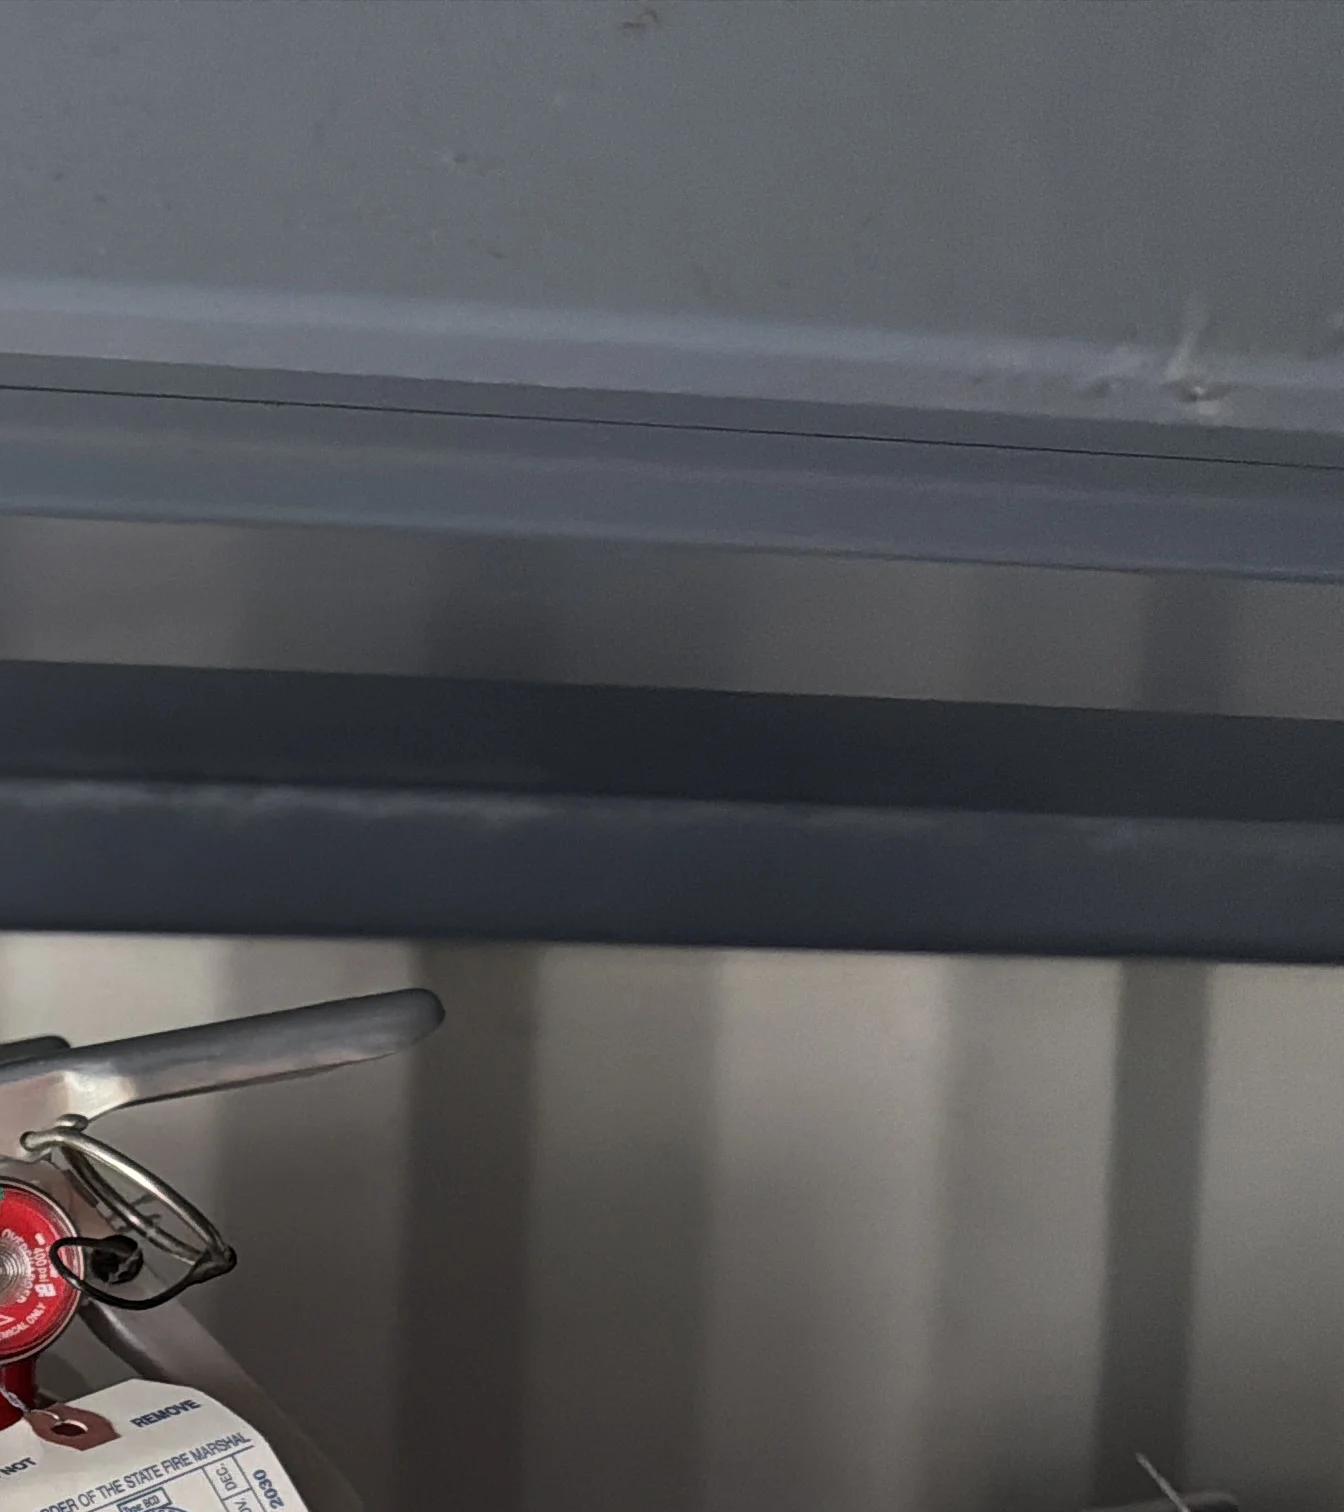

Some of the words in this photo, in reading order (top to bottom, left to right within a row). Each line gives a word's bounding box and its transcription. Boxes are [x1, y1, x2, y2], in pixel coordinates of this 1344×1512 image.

[129, 1399, 201, 1428] REMOVE
[0, 1457, 36, 1475] NOT
[77, 1489, 96, 1507] OF
[94, 1478, 126, 1499] THE
[123, 1464, 164, 1489] STATE
[160, 1452, 193, 1474] FIRE
[188, 1431, 252, 1462] MARSHAL
[252, 1469, 284, 1509] 2030
